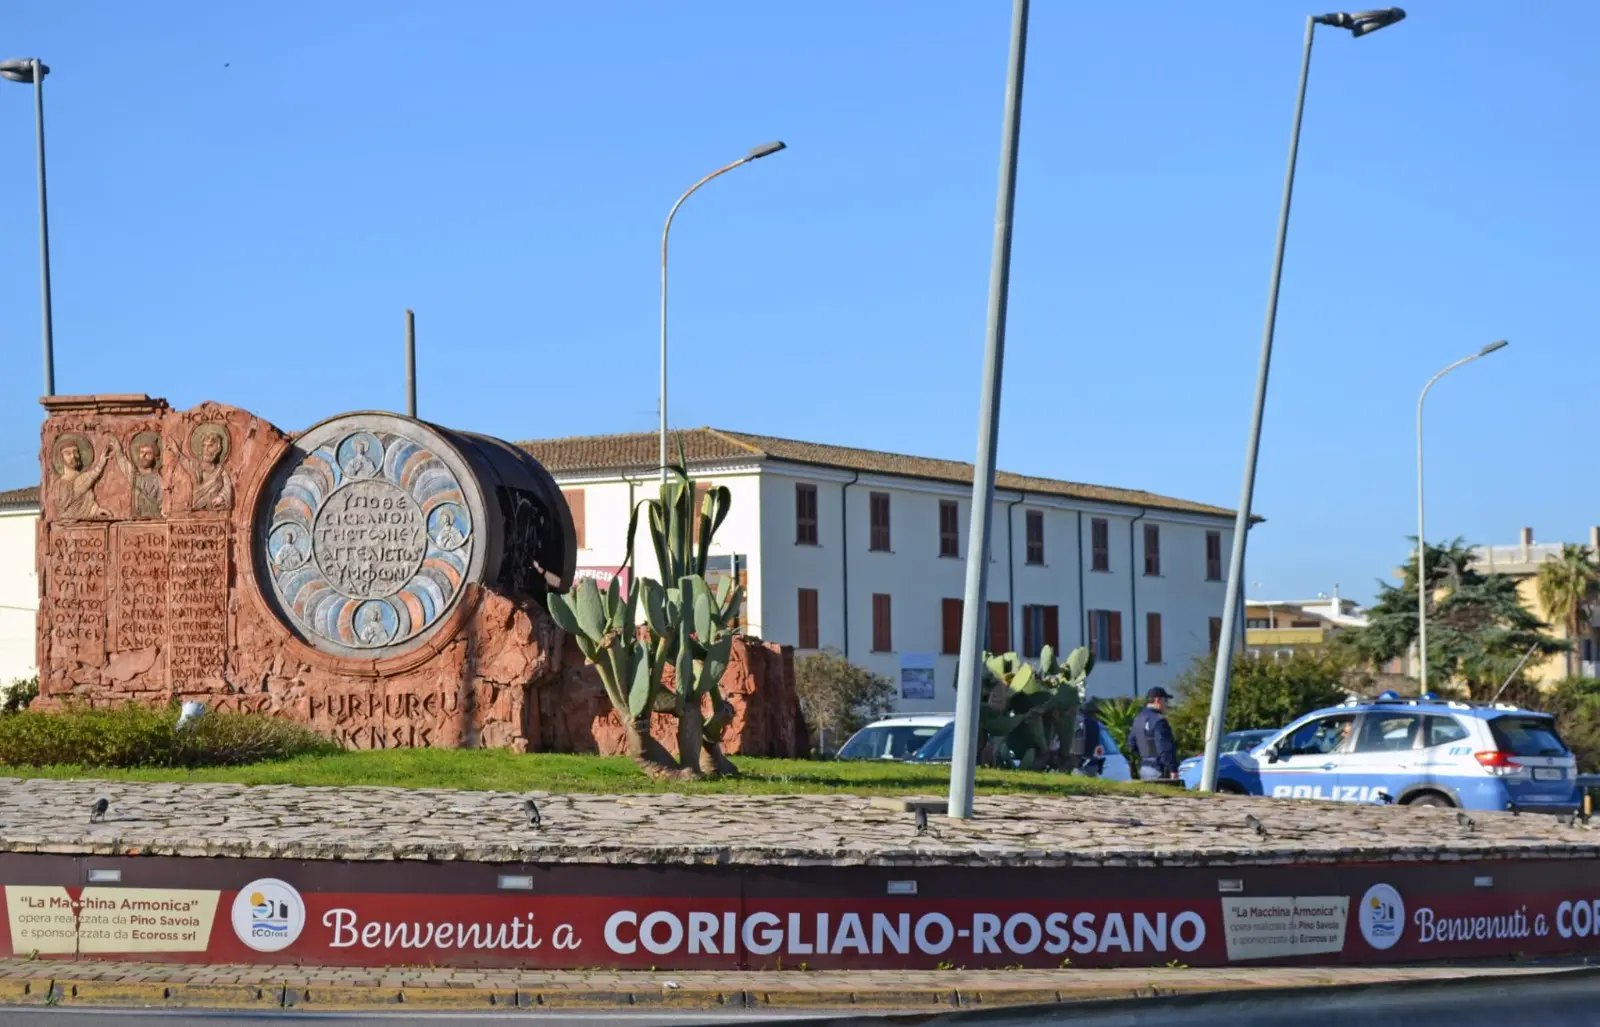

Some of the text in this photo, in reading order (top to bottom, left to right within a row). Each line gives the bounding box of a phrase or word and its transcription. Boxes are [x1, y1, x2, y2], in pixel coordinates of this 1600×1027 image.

[1272, 784, 1389, 804] POLIZIA
[49, 897, 116, 910] Macchina
[18, 913, 200, 926] opera realzzata da Pino Savoia
[1414, 904, 1531, 943] Benvenuti
[1534, 913, 1550, 937] a
[20, 928, 196, 941] e sponsorzzata da Ecoross srl
[322, 908, 1206, 955] Benvenuti a CORIGLIANO-ROSSANO
